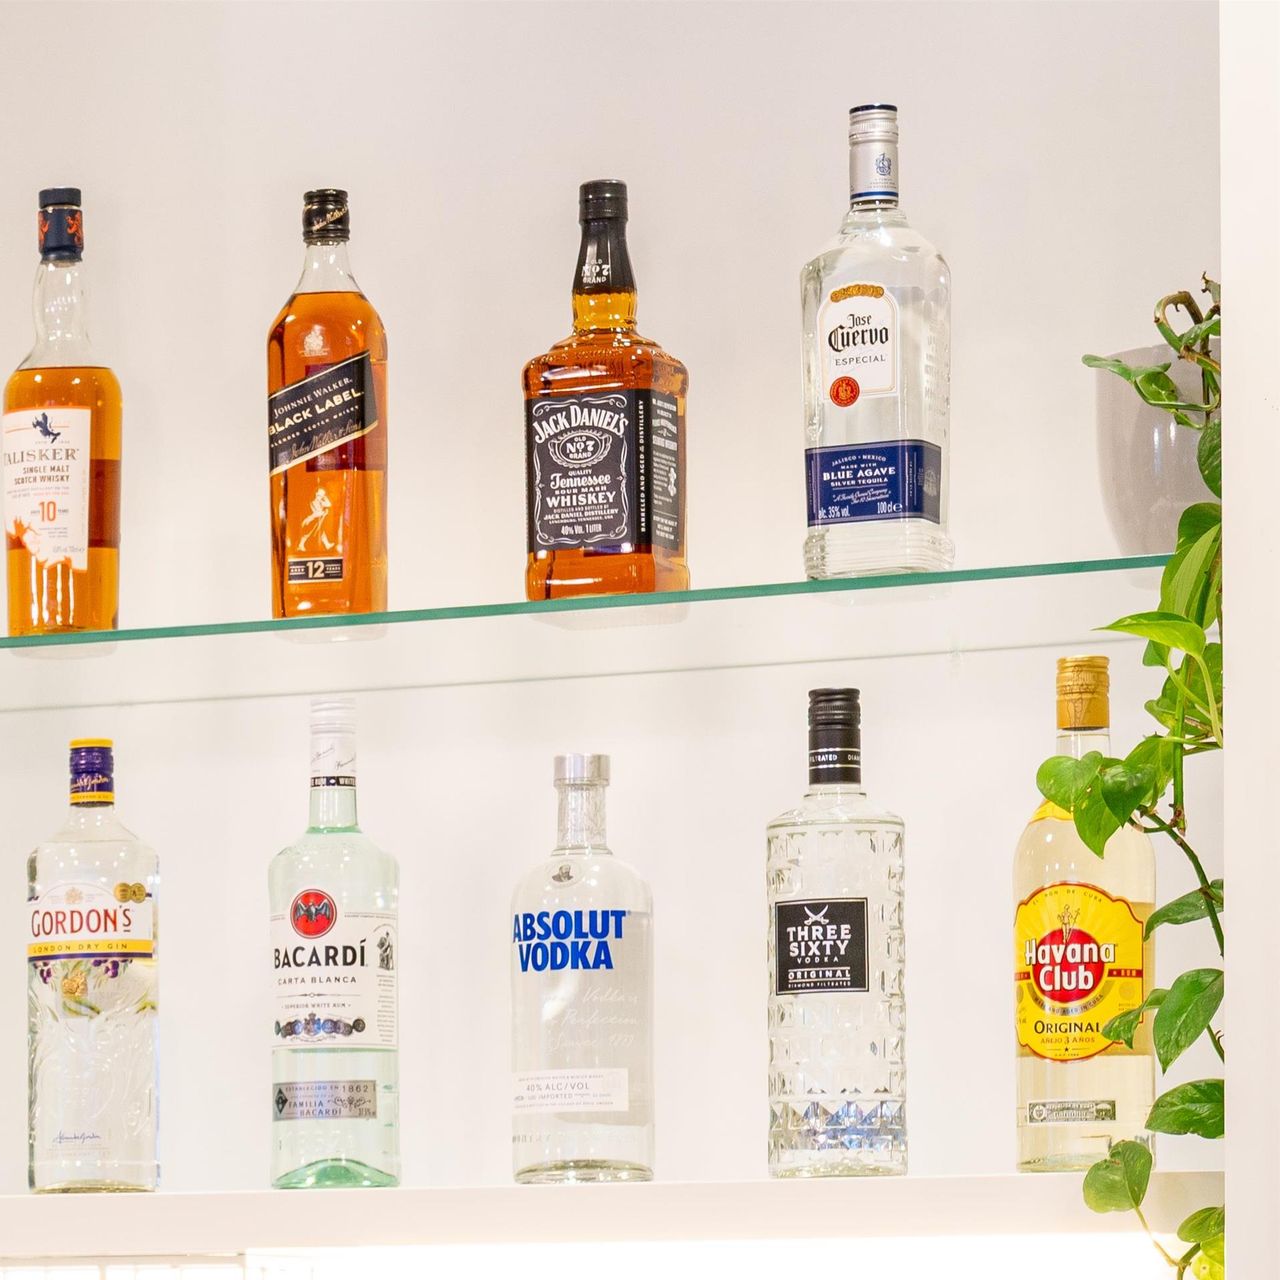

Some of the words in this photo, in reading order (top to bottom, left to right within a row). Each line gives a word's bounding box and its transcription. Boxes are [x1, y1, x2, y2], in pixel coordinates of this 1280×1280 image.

[847, 314, 872, 329] Jose
[828, 324, 889, 352] Cuervo
[835, 354, 886, 366] ESPECIAL
[268, 408, 312, 435] BLACK
[315, 388, 361, 414] LABEL
[274, 394, 313, 419] JOHNNIE
[533, 410, 570, 443] JACK
[570, 405, 629, 437] DANIEL'S
[4, 448, 76, 466] TALISKER
[862, 454, 887, 462] MEXICO
[22, 466, 48, 475] SINGLE
[50, 465, 70, 473] MALT
[823, 470, 854, 481] BLUE
[856, 467, 896, 478] AGAVE
[14, 476, 37, 485] SCOTCH
[39, 475, 70, 483] WHISKY
[550, 472, 612, 489] Tennessee
[858, 478, 889, 486] TEQUILA
[546, 491, 616, 508] WHISKEY
[38, 501, 57, 521] 10
[828, 506, 841, 519] 35%
[877, 501, 888, 514] 100
[306, 561, 325, 578] 12
[1083, 891, 1102, 903] CUBA
[32, 904, 132, 937] GORDON'S
[513, 910, 627, 943] ABSOLUT
[786, 924, 852, 942] THREE
[33, 945, 71, 953] LONDON
[274, 938, 367, 969] BACARDÍ
[519, 941, 614, 972] VODKA
[789, 940, 849, 957] SIXTY
[1025, 938, 1116, 966] Havana
[797, 956, 839, 964] VODKA
[278, 977, 306, 986] CARTA
[311, 976, 357, 984] BLANCA
[788, 969, 851, 979] ORIGINAL
[1039, 964, 1095, 992] Club
[1034, 1020, 1100, 1034] ORIGINAL
[1064, 1036, 1070, 1045] 3
[342, 1084, 368, 1093] 1862
[526, 1083, 542, 1092] 40%
[545, 1082, 590, 1091] ALC/VOL
[288, 1100, 324, 1108] FAMILIA
